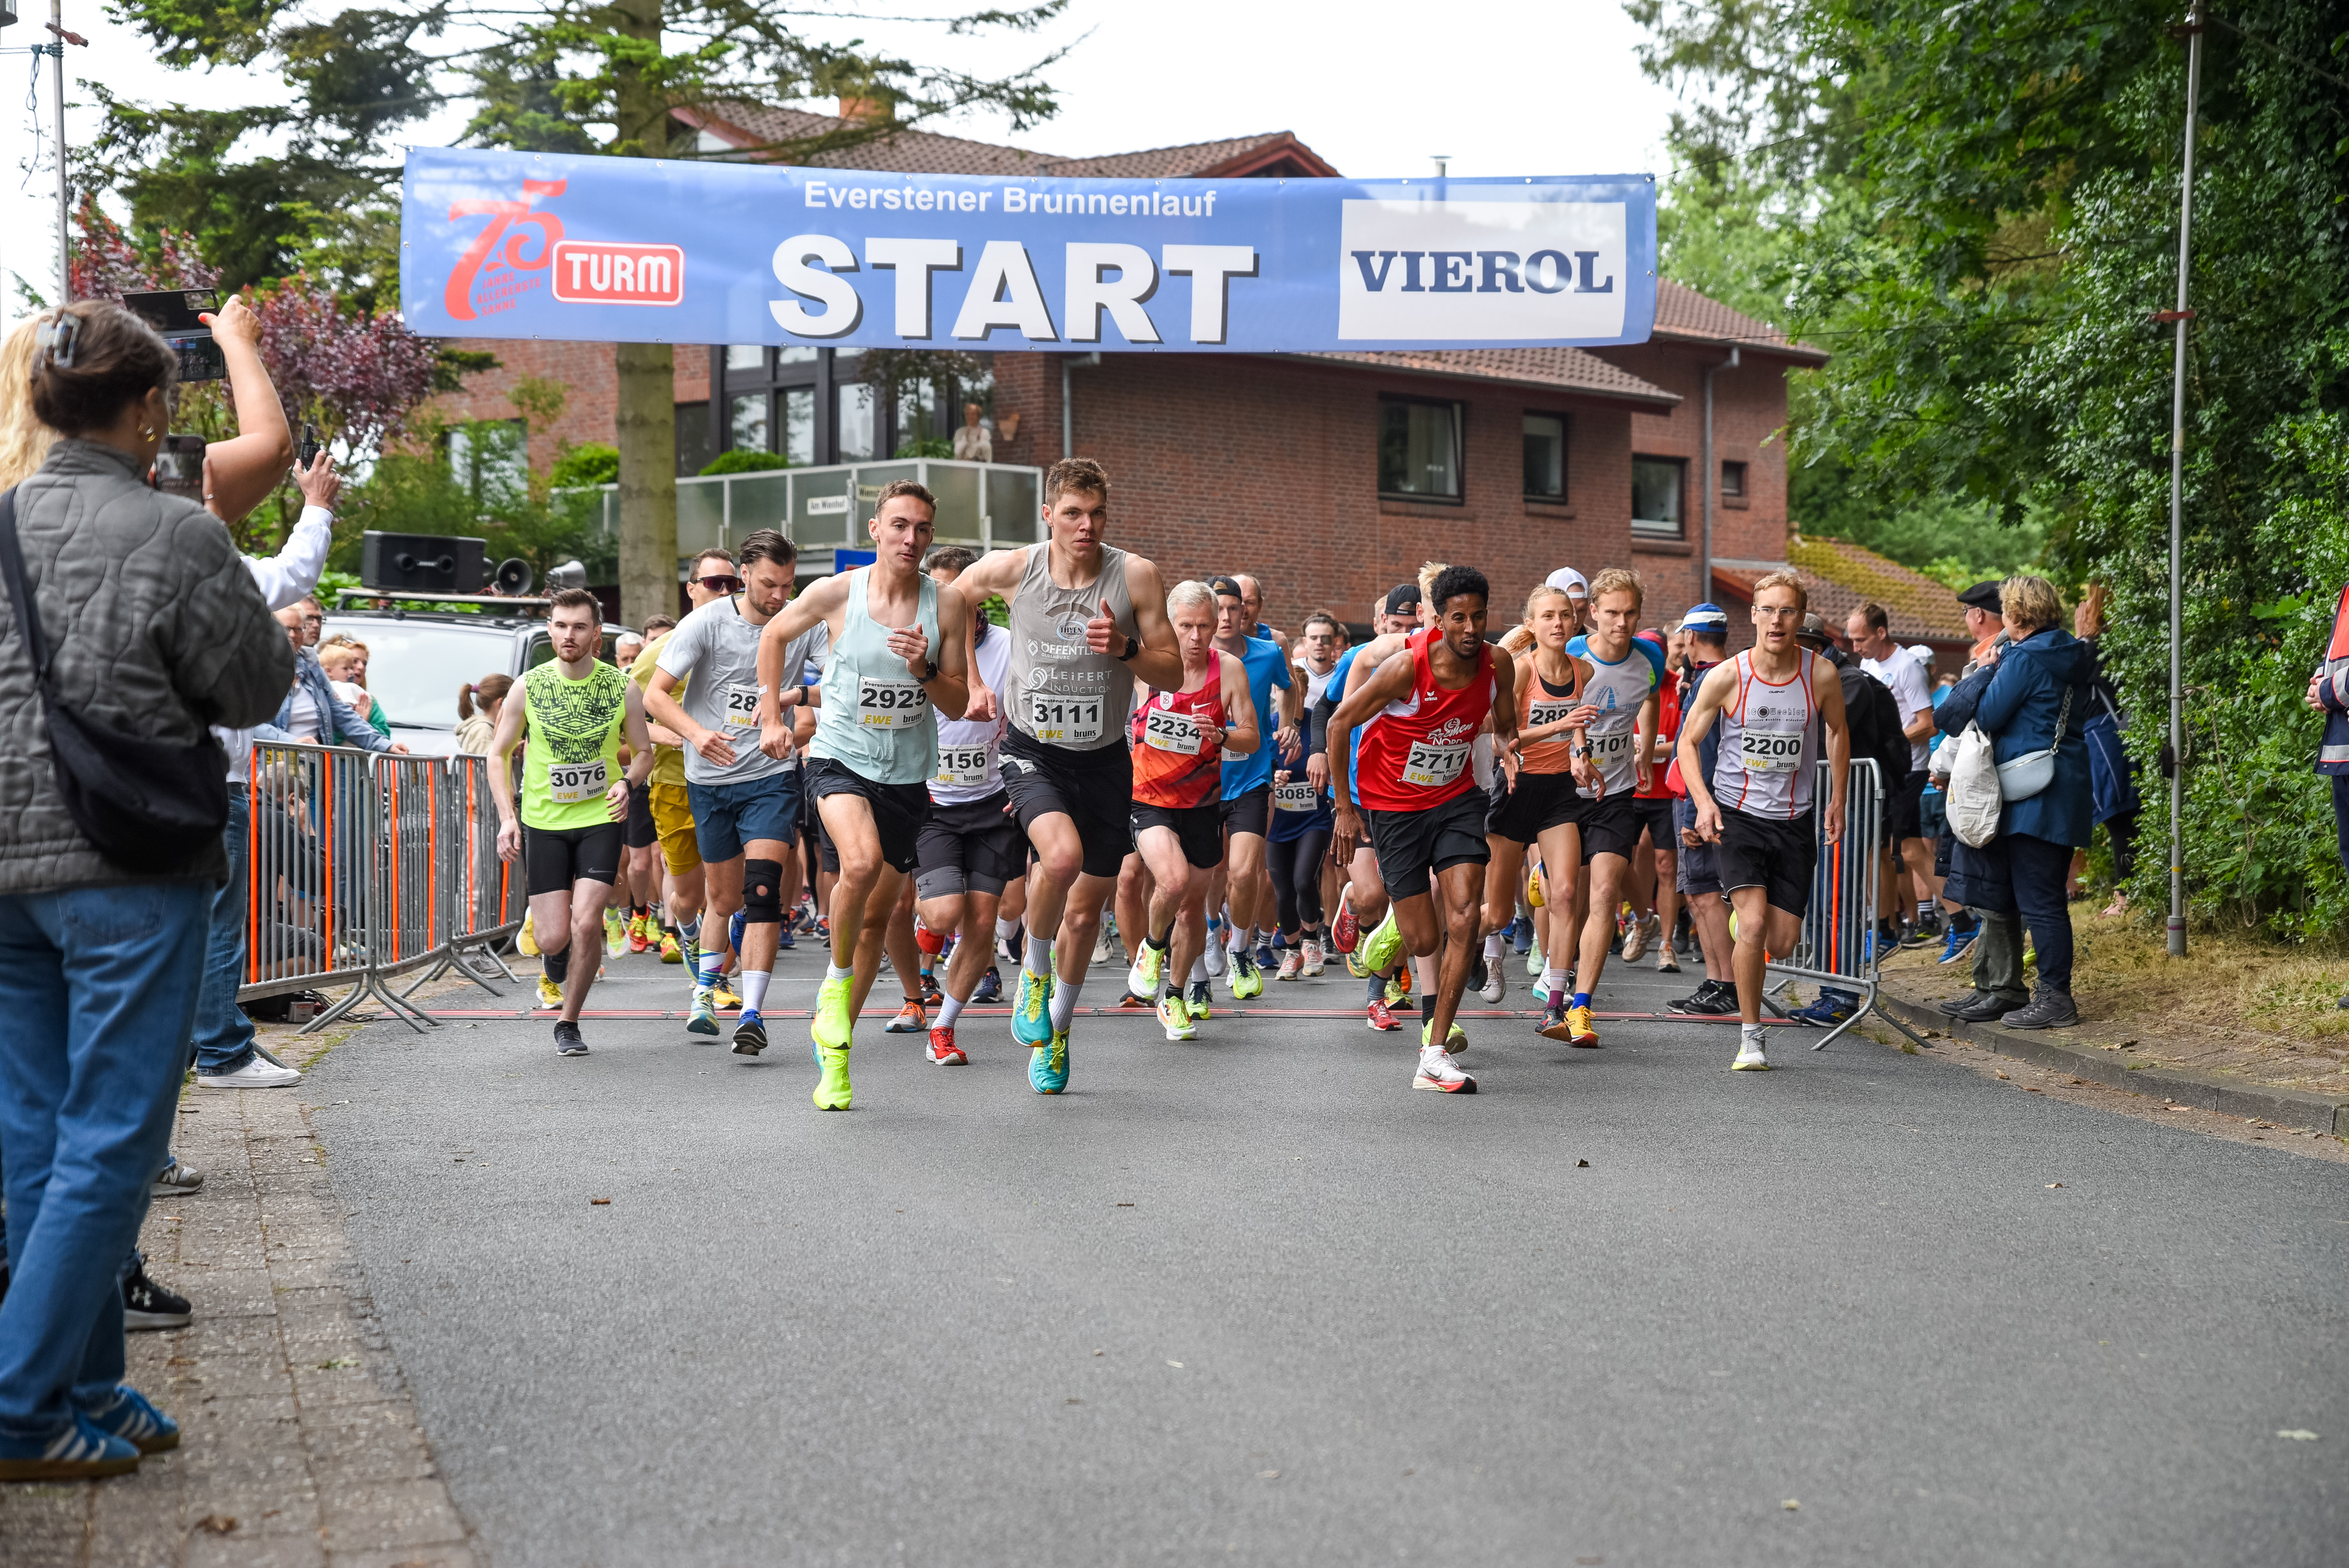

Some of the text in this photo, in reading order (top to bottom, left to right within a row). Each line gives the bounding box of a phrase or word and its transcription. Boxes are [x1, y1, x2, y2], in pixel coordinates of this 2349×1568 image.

[805, 181, 1216, 217] Everstener Brunnenlauf
[483, 271, 514, 290] JAHRE
[565, 253, 672, 293] TURM
[1350, 249, 1613, 294] VIEROL
[477, 277, 541, 304] ALLERERSTE
[768, 234, 1258, 345] START
[482, 298, 516, 316] SAHNE
[811, 499, 845, 510] Am Wienhof
[1041, 642, 1100, 655] ÖFFENTLI
[1050, 682, 1111, 694] INDUCTION
[728, 693, 761, 712] 28
[860, 688, 927, 709] 2925
[864, 715, 892, 724] EWE
[903, 712, 922, 723] bruns
[1034, 704, 1097, 723] 3111
[1153, 711, 1176, 720] Everstener
[1529, 707, 1577, 725] 288
[1770, 708, 1806, 717] Wechloy
[1038, 730, 1063, 739] EWE
[1147, 716, 1201, 740] 2234
[1427, 722, 1474, 740] Bremen
[1149, 736, 1195, 751] EWE bruns
[1586, 734, 1628, 753] 3101
[1742, 737, 1801, 755] 2200
[938, 752, 986, 769] 156
[1409, 751, 1467, 769] 2711
[1611, 754, 1624, 763] bruns
[1746, 758, 1767, 768] EWE
[551, 766, 606, 787] 3076
[934, 774, 954, 782] WE
[1410, 772, 1434, 782] EWE
[1442, 773, 1458, 781] bruns
[557, 791, 578, 800] EWE
[587, 786, 604, 795] bruns
[1275, 787, 1315, 800] 3085
